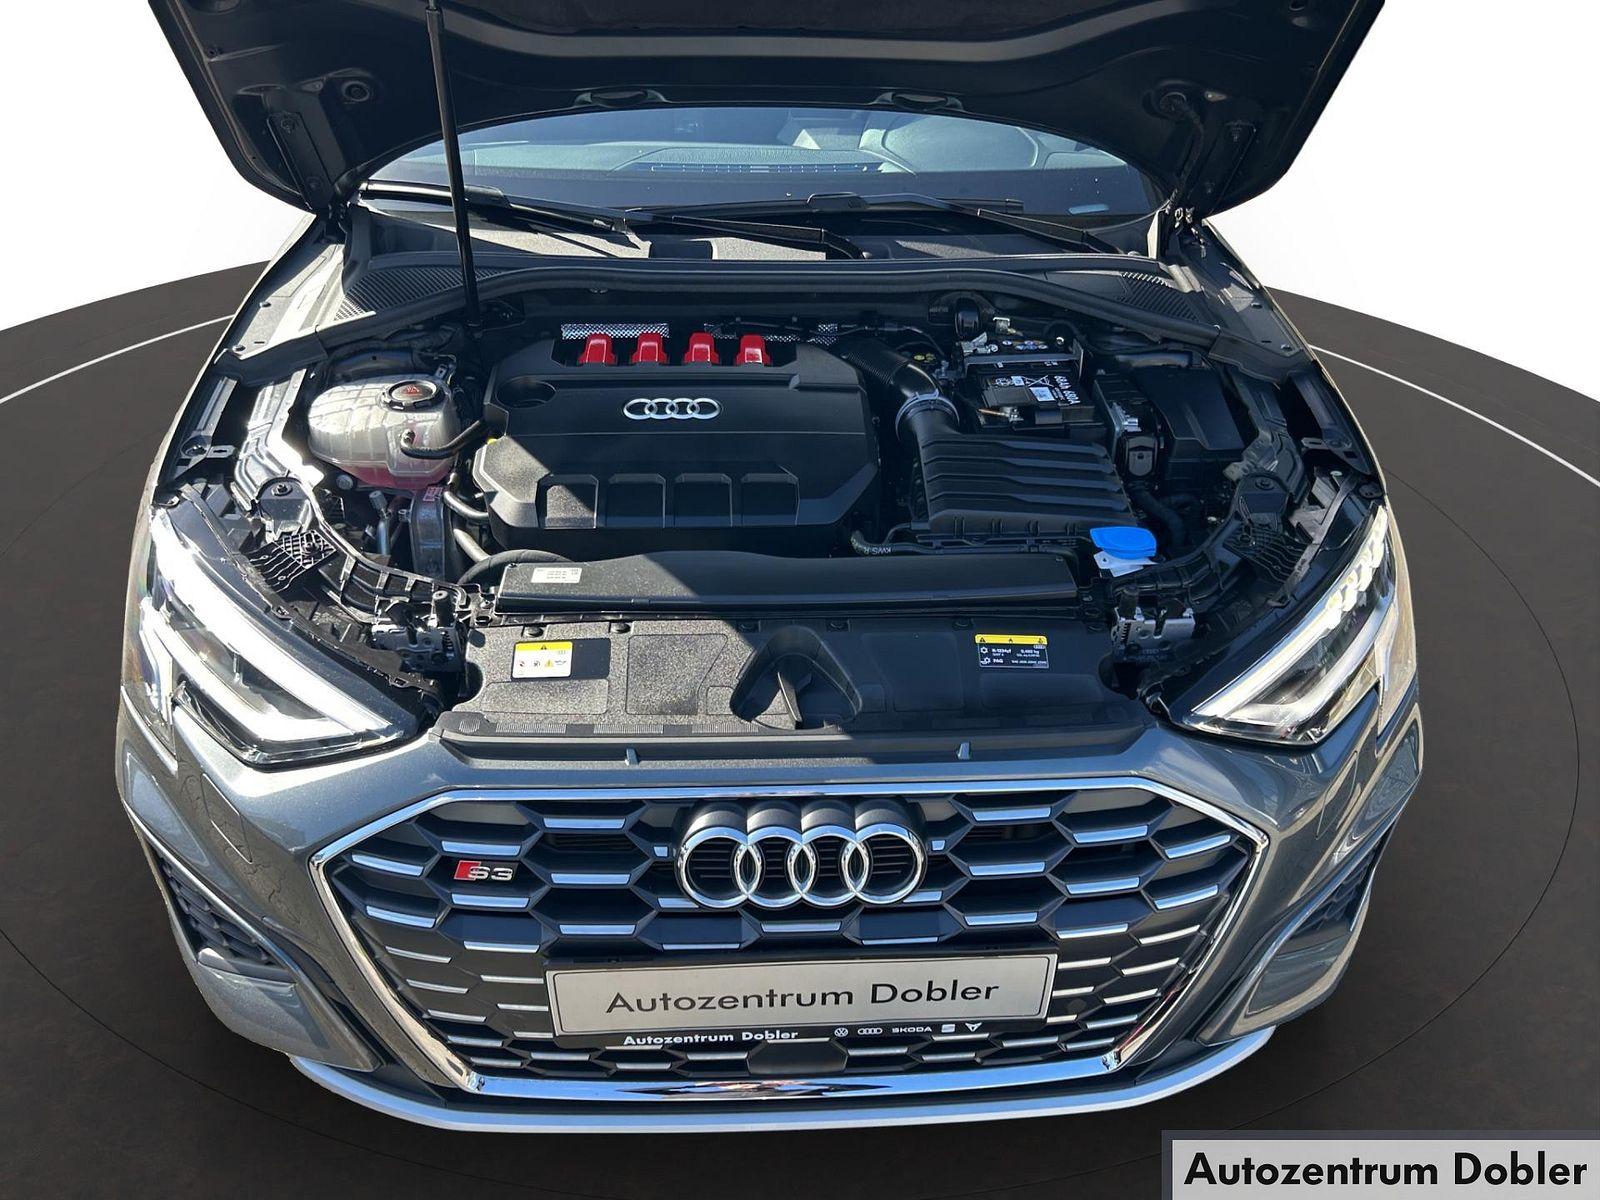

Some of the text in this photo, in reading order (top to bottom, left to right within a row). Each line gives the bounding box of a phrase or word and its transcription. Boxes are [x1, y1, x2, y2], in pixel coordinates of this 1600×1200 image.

[468, 866, 513, 881] S3
[606, 979, 999, 1013] Autozentrum Dobler
[623, 1030, 799, 1046] Autozentrum Dobler
